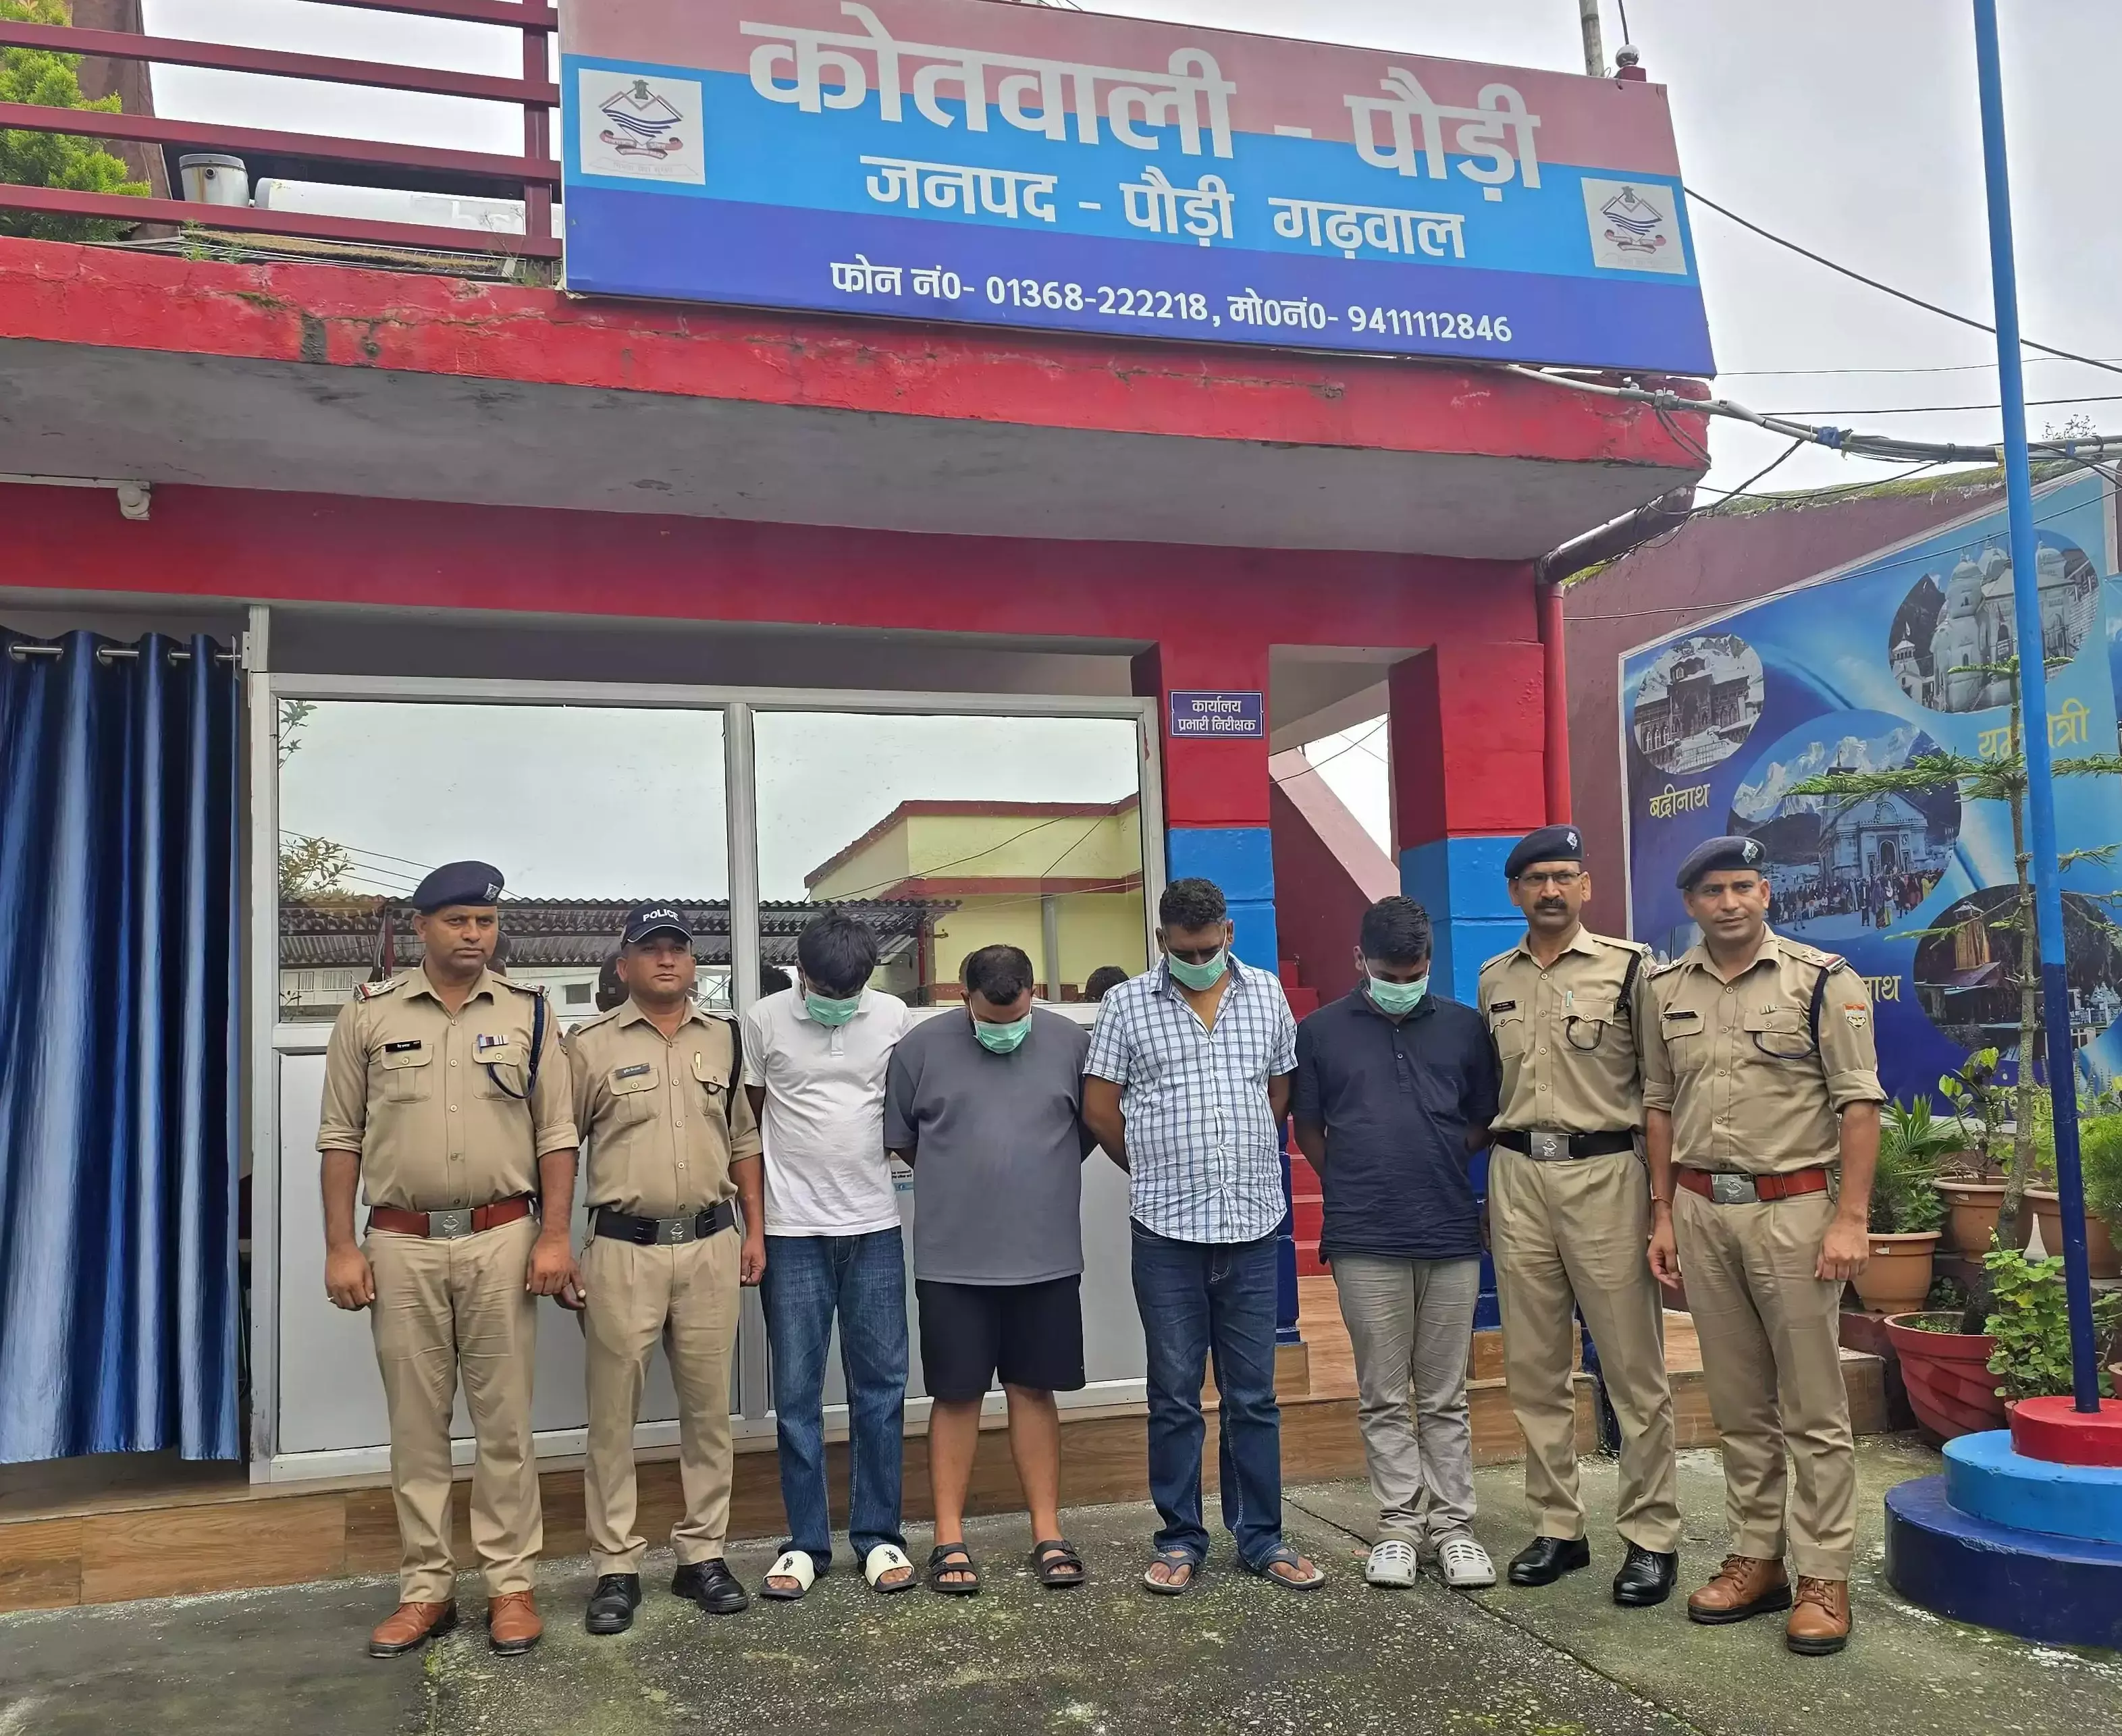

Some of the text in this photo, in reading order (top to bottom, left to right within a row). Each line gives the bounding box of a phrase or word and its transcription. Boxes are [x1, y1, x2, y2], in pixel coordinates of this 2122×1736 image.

[739, 1, 1236, 159] कोतवाली
[1344, 67, 1540, 202] पौड़ी
[860, 155, 1057, 222] जनपद
[1120, 166, 1235, 246] पौड़ी
[1269, 197, 1465, 259] गढ़वाल
[830, 254, 902, 296] फोन
[1348, 306, 1512, 342] 9411112846
[1192, 695, 1242, 713] कार्यालय
[1211, 715, 1256, 731] निरीक्षक
[1649, 783, 1710, 818] बद्रीनाथ
[643, 908, 679, 922] POLICE
